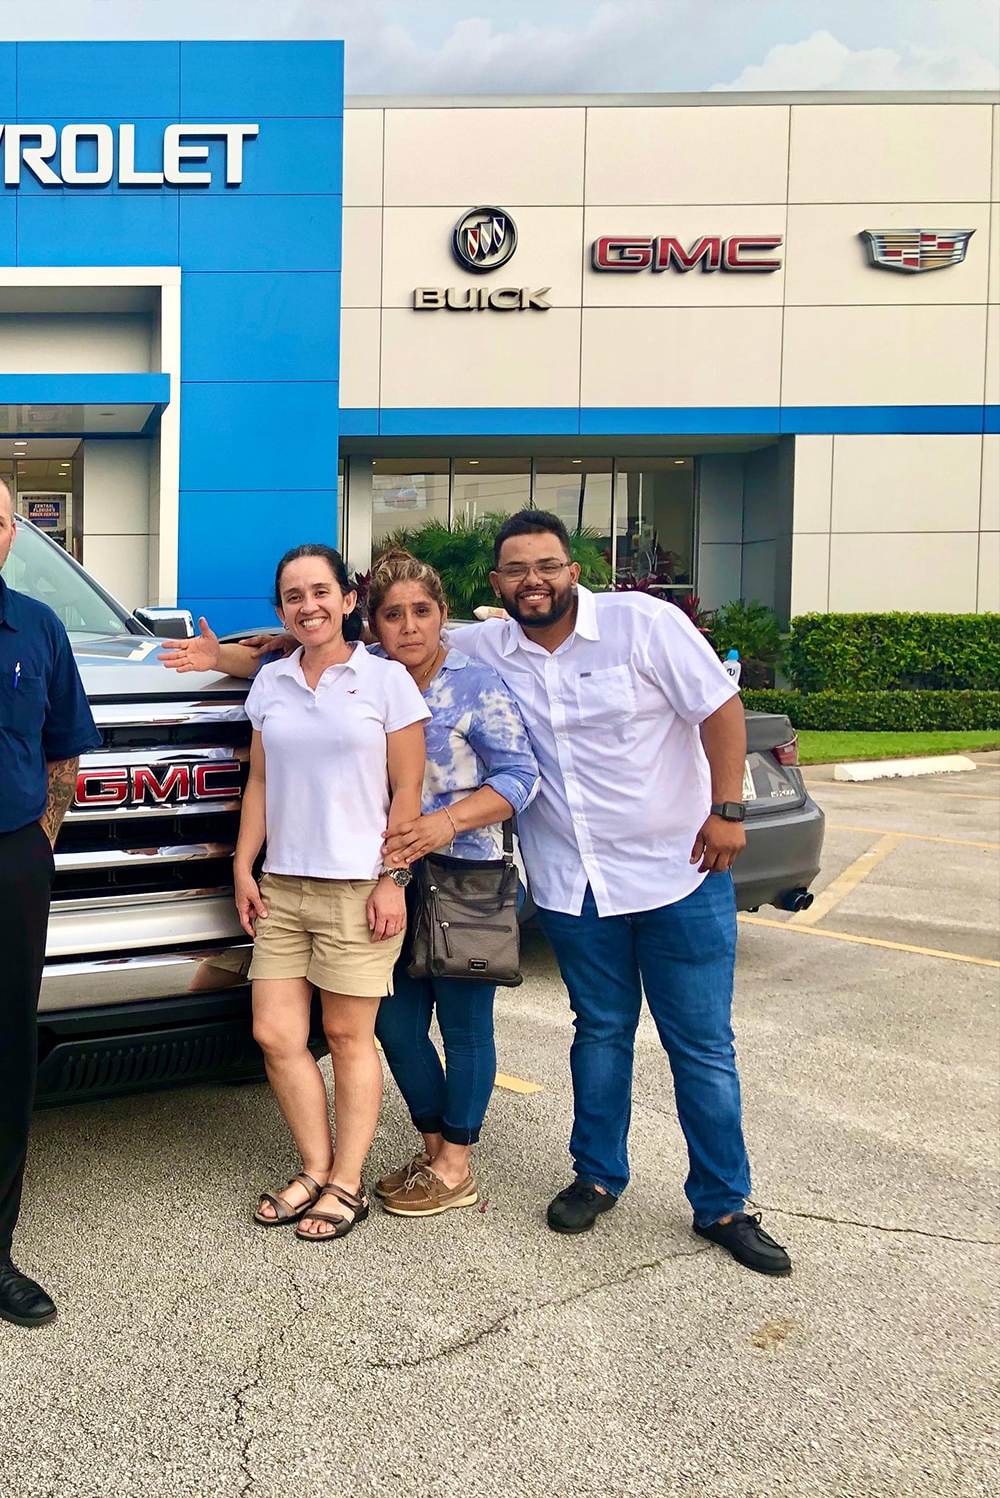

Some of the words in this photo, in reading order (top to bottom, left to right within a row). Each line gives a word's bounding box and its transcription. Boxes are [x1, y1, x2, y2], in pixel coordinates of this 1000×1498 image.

[592, 234, 784, 275] GMC
[412, 285, 554, 312] BUICK
[74, 761, 242, 807] GMC
